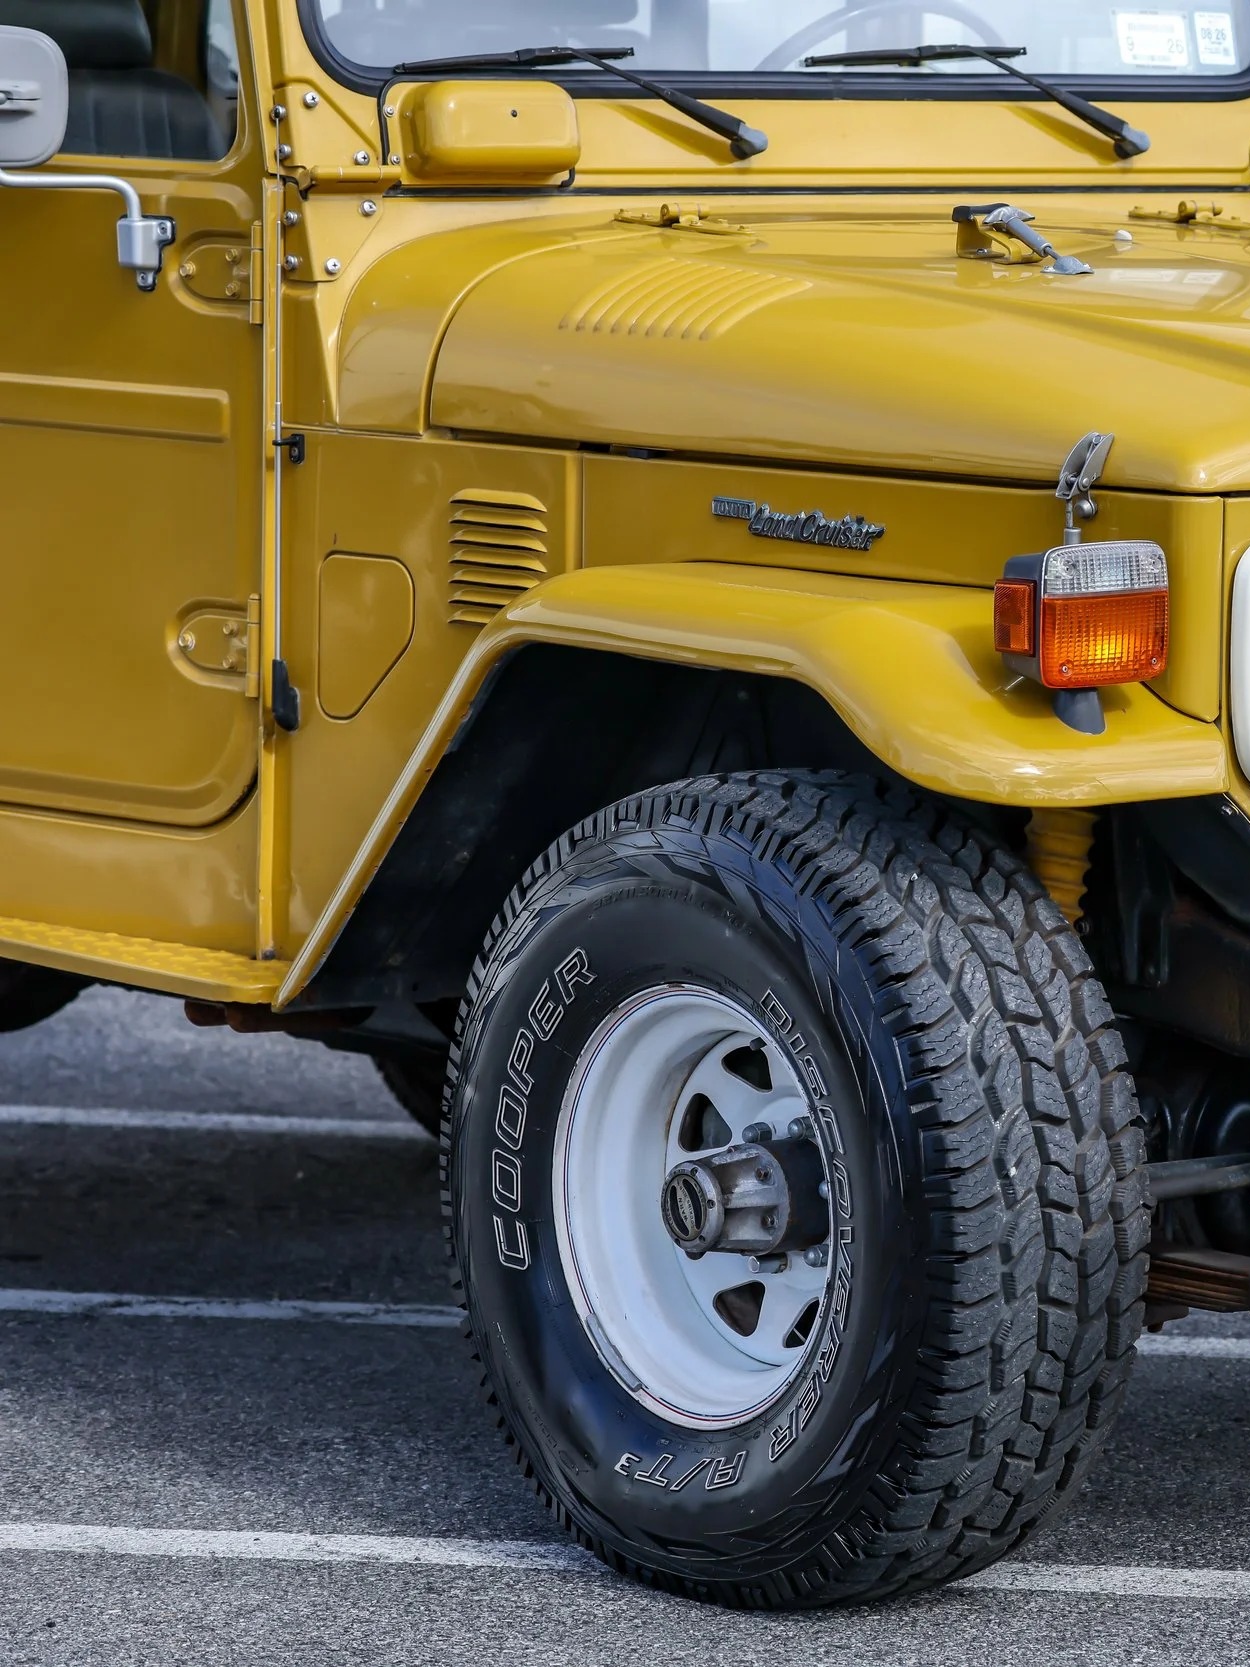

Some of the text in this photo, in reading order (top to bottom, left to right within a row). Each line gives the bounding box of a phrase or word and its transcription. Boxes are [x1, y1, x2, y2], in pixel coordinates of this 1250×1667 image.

[1167, 38, 1185, 54] 26
[714, 499, 885, 550] TOYOTA Land Cruiser
[490, 946, 598, 1271] COOPER
[759, 987, 854, 1463] DISCOVERER
